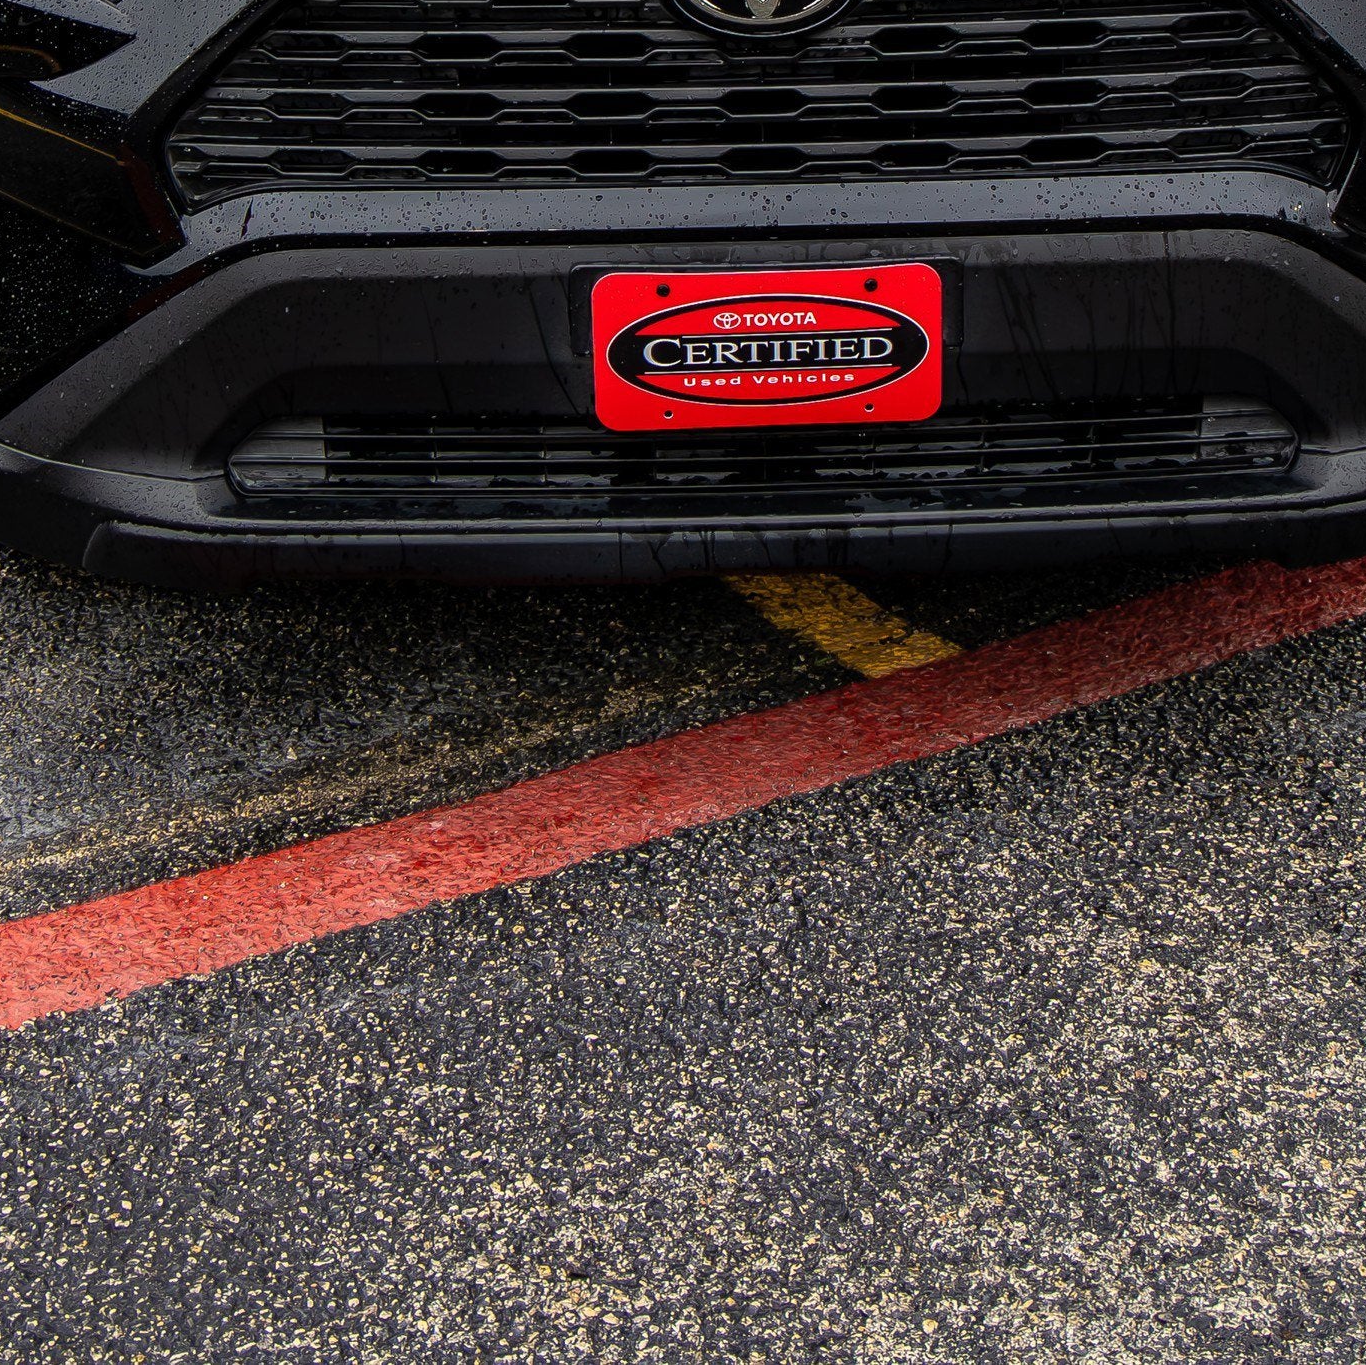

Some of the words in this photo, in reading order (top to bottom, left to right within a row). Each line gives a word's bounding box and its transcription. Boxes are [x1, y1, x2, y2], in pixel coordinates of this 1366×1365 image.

[742, 312, 817, 327] TOYOTA
[683, 376, 742, 388] Used
[753, 372, 856, 385] Vehicles
